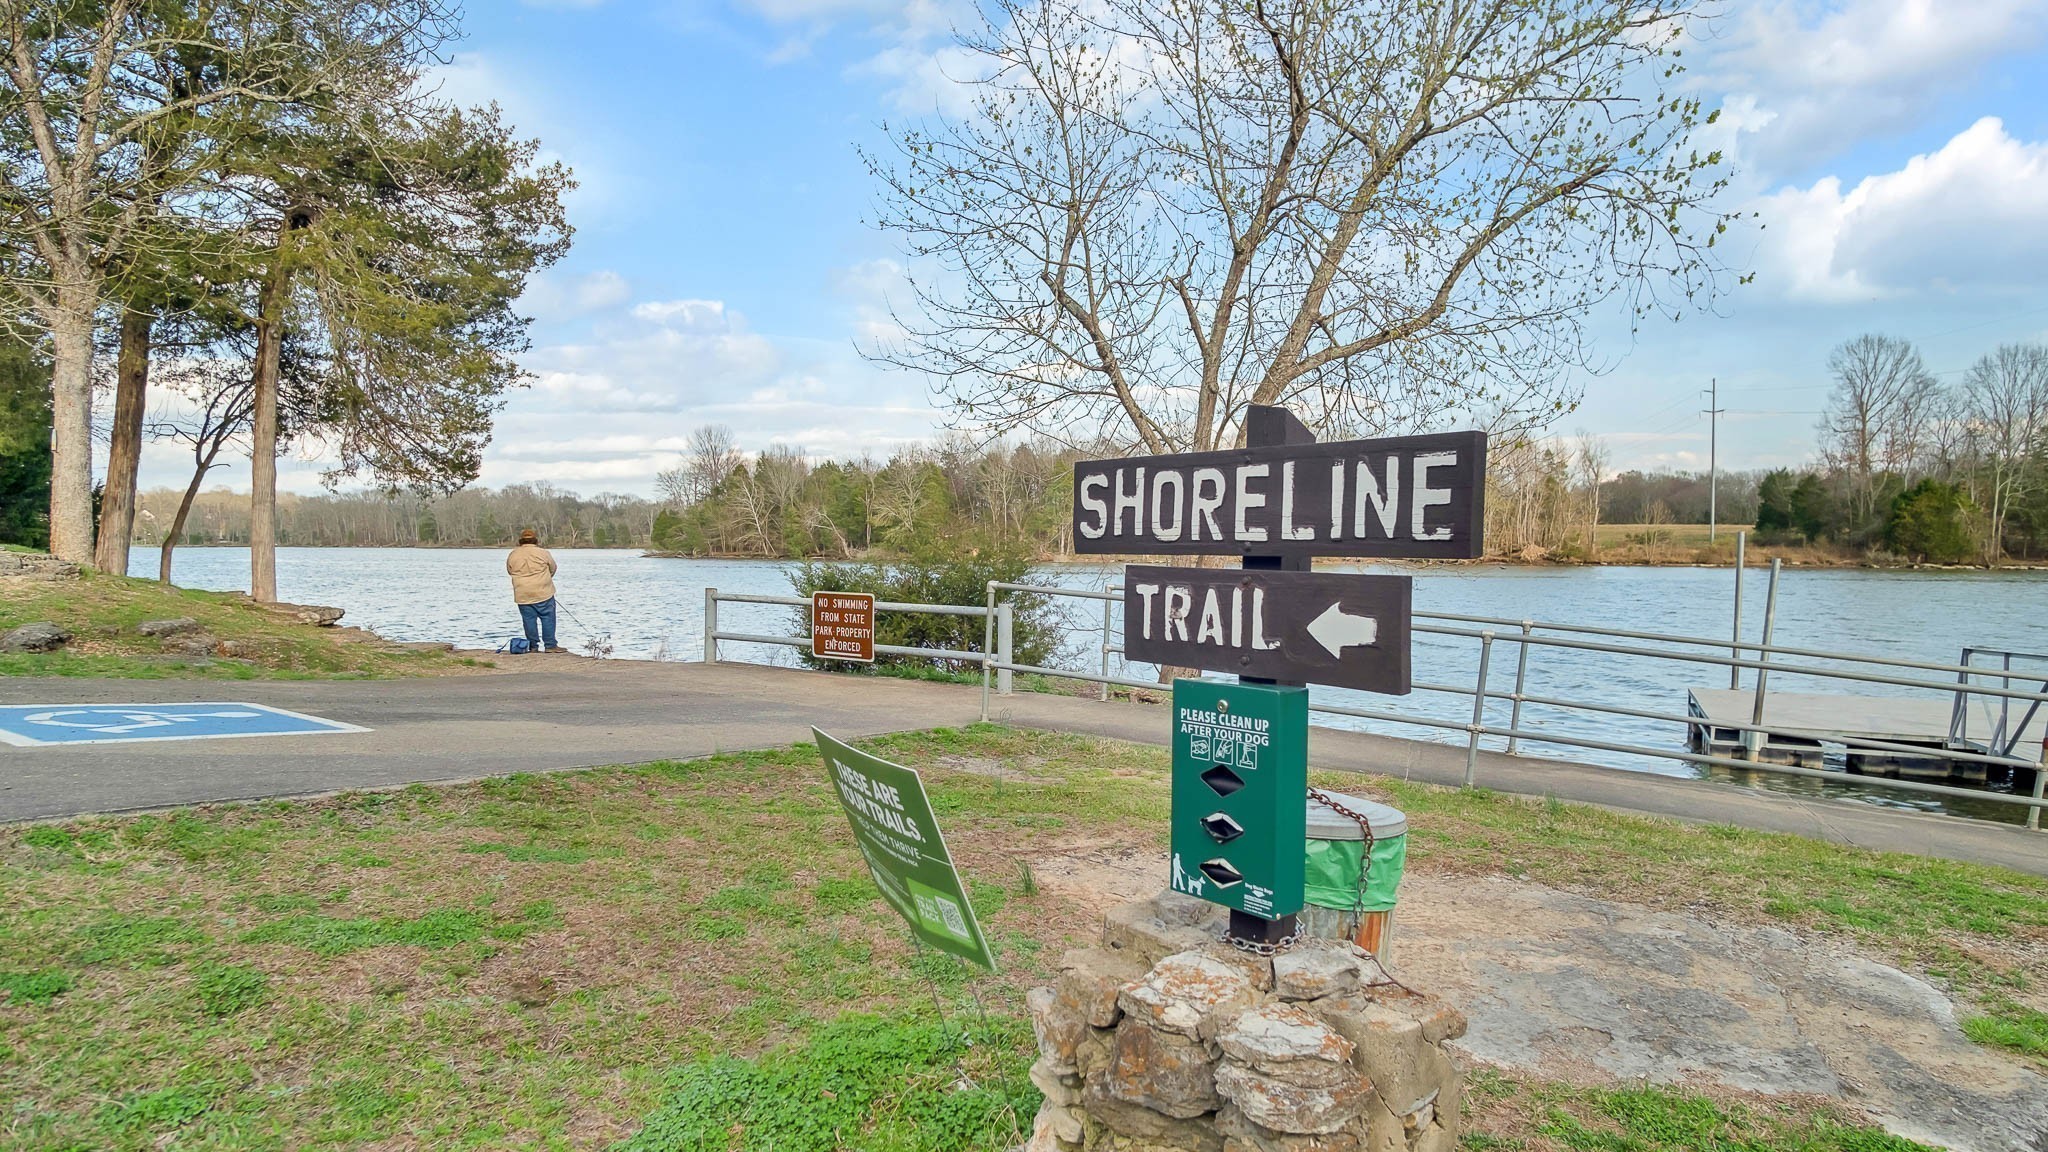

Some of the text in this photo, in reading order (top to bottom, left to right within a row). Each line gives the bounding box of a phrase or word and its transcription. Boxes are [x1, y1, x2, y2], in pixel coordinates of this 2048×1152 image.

[1079, 450, 1457, 542] SHORELINE
[818, 598, 868, 610] NO SWIMMING
[820, 612, 865, 624] FROM STATE
[1136, 583, 1281, 650] TRAIL
[815, 625, 871, 639] PARK PROPERTY
[825, 640, 861, 652] ENFORCED
[1180, 708, 1269, 732] PLEASE CLEAN UP
[1180, 723, 1269, 746] AFTER YOUR DOG
[832, 757, 904, 811] THESE ARE
[837, 779, 871, 817] YOUR
[865, 798, 927, 843] TRAILS.
[889, 836, 921, 860] THRIVE
